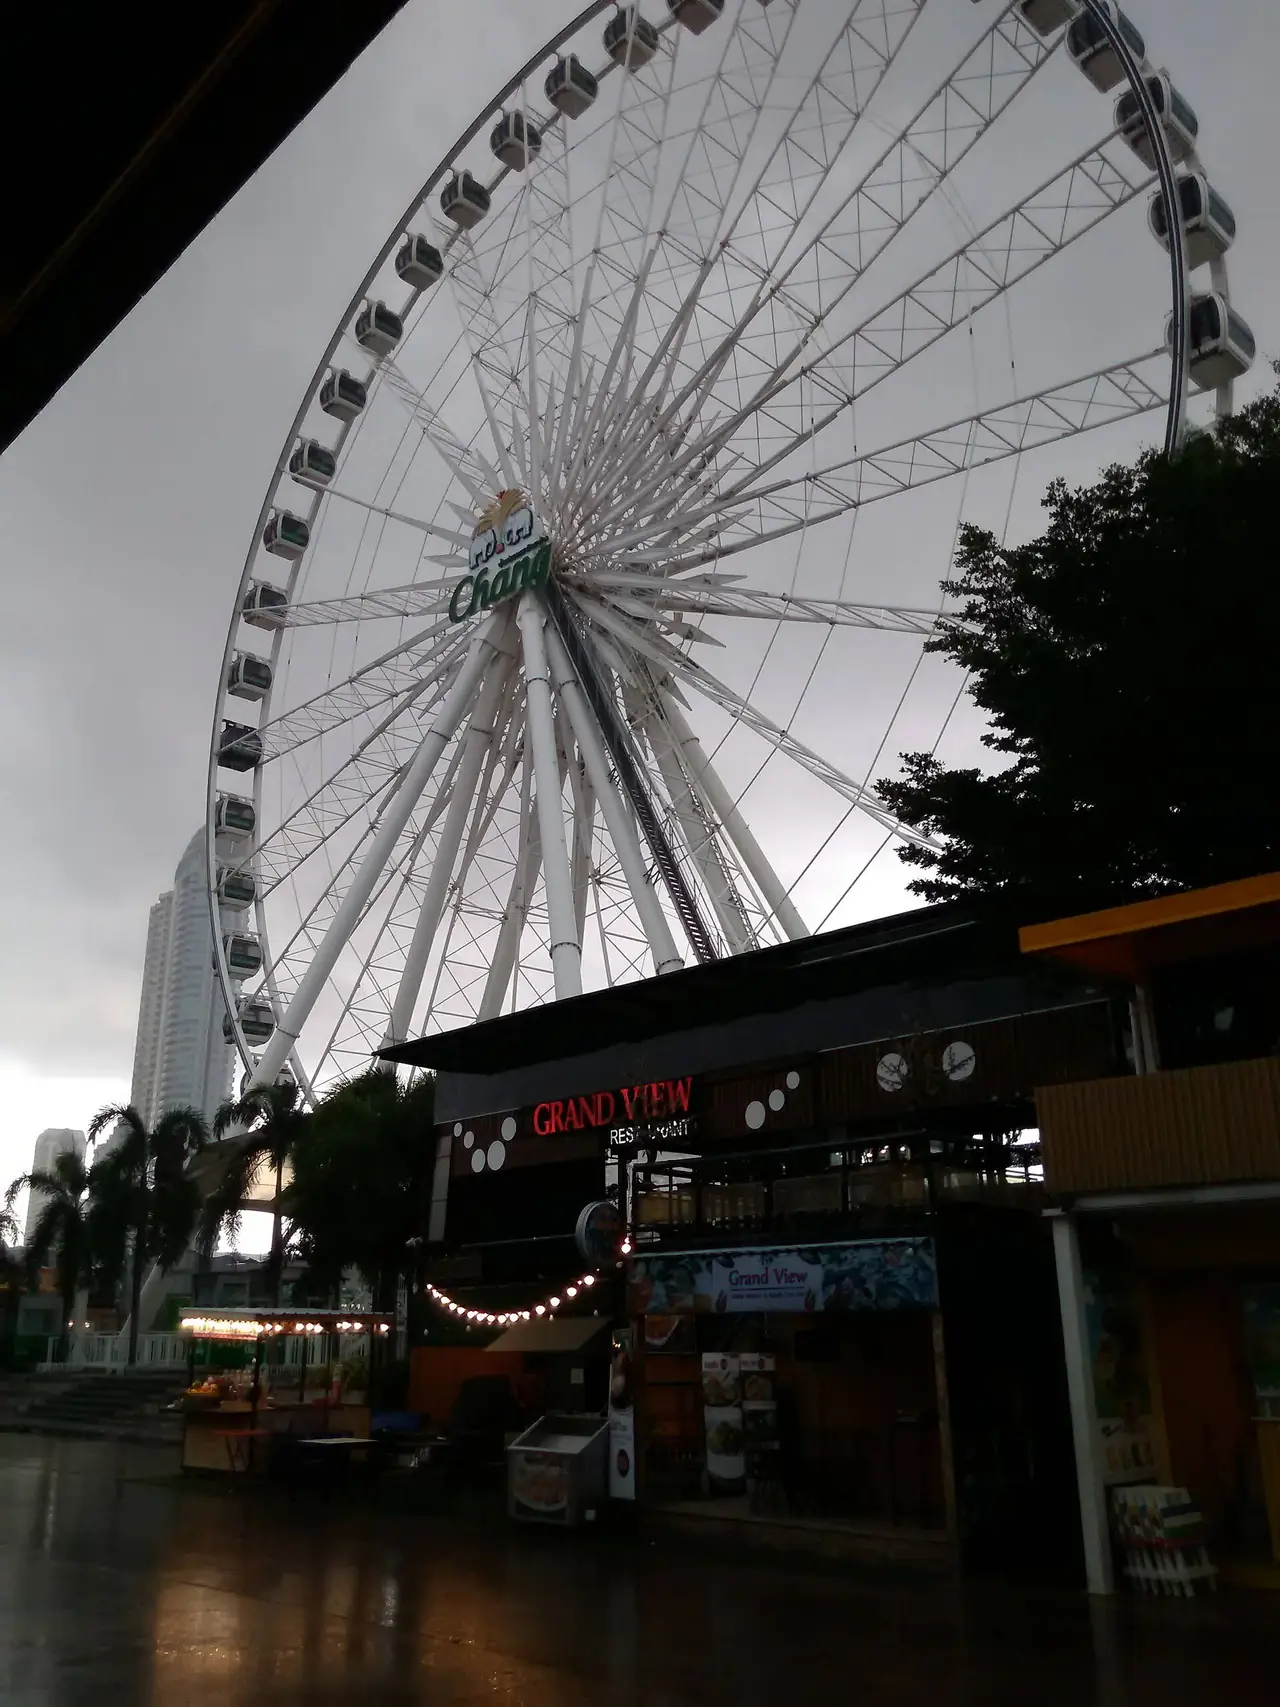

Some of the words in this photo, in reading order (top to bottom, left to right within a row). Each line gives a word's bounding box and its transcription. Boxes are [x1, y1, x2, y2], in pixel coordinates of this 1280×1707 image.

[449, 545, 552, 623] Chang
[533, 1090, 616, 1137] GRAND
[620, 1075, 694, 1121] VIEW
[729, 1267, 768, 1286] Grand
[773, 1267, 808, 1284] View
